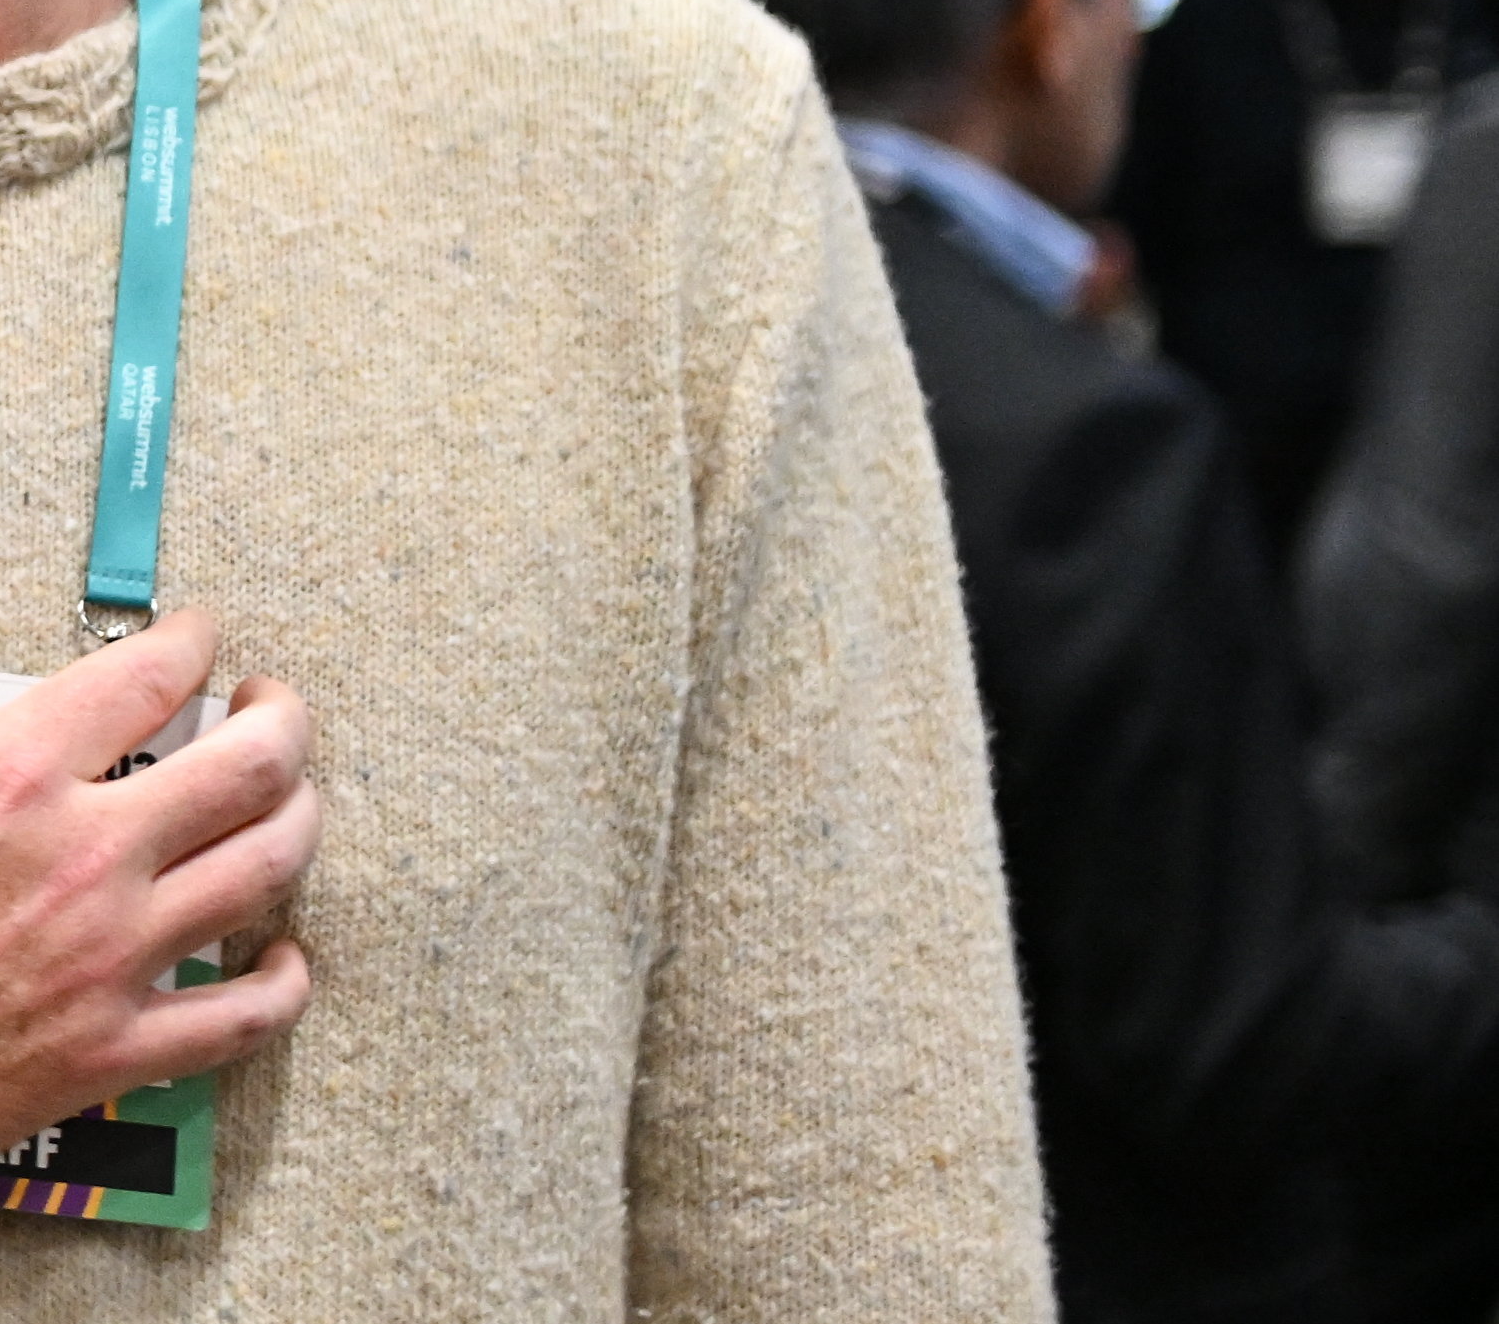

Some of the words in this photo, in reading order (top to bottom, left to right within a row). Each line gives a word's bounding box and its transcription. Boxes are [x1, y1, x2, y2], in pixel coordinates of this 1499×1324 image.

[140, 104, 161, 183] LISBON
[155, 106, 184, 227] websummit
[118, 362, 139, 421] QATAR
[129, 365, 162, 492] websummit
